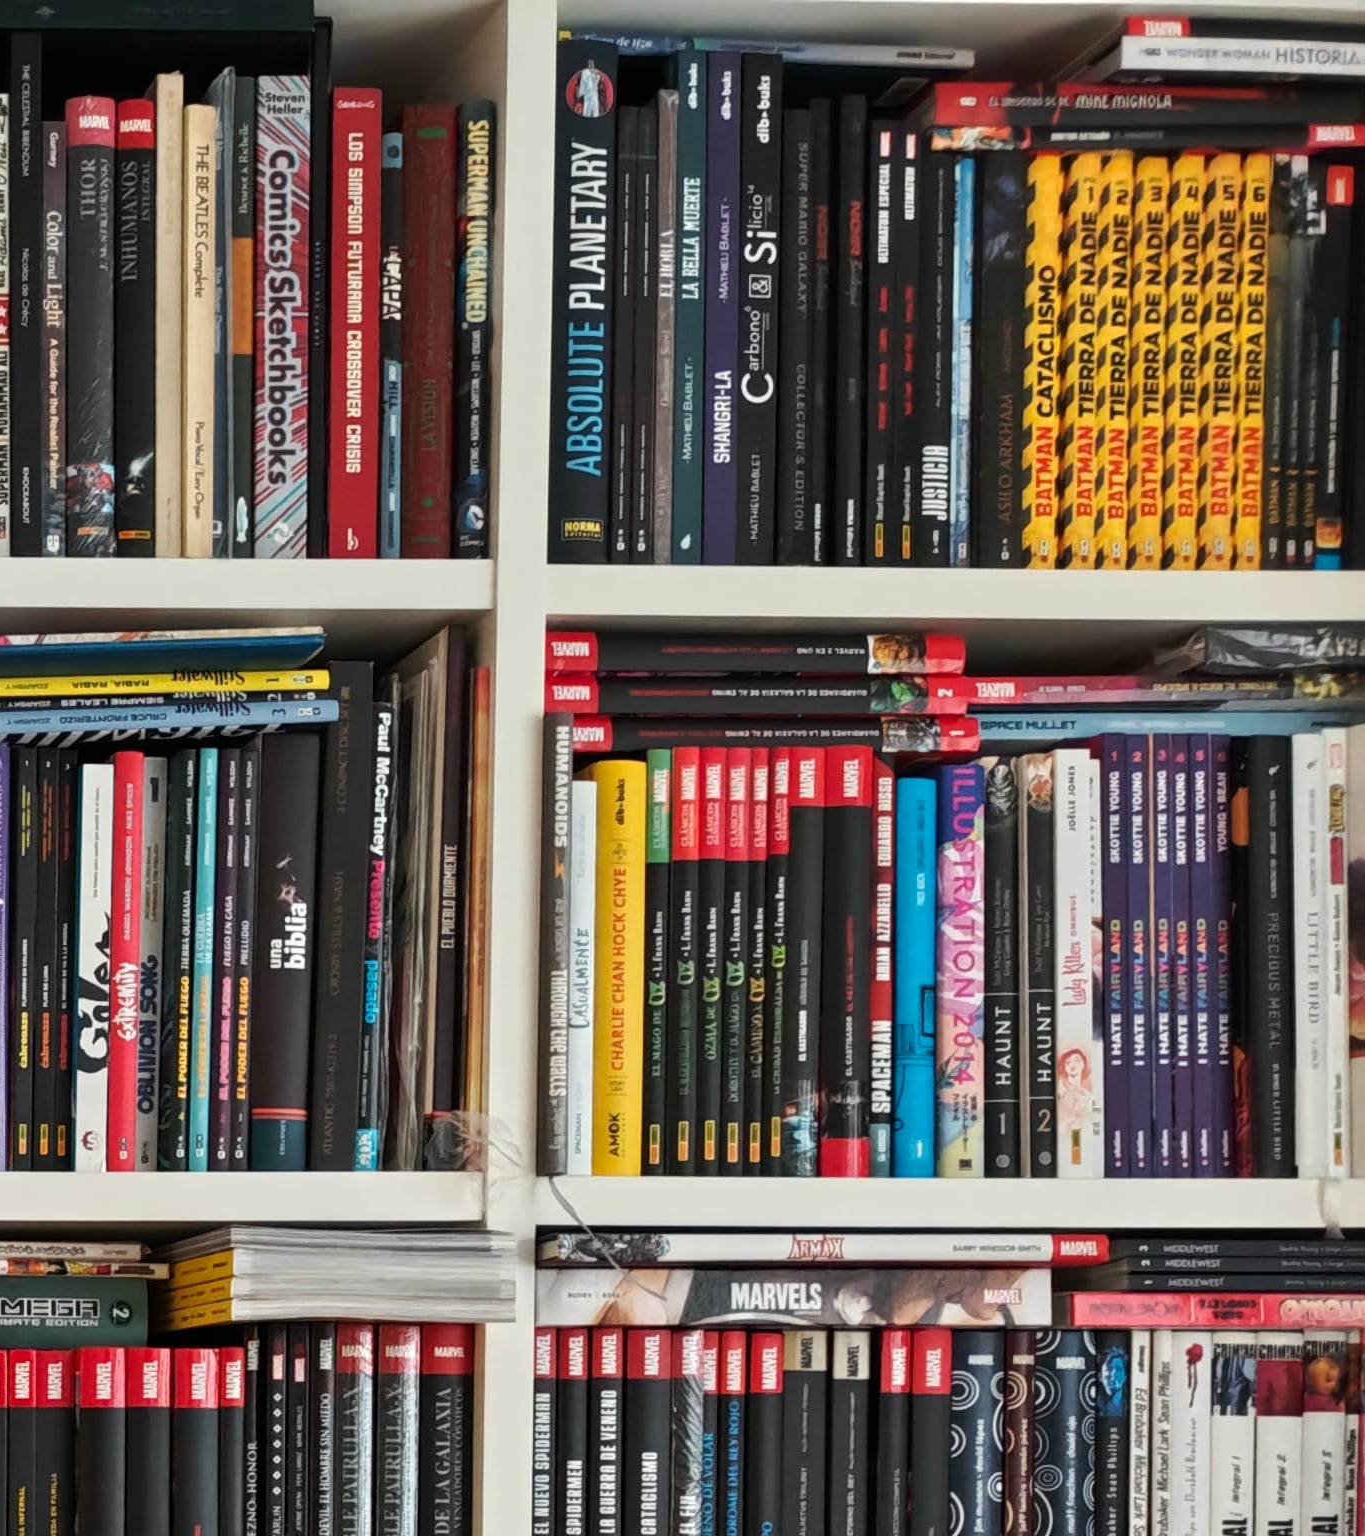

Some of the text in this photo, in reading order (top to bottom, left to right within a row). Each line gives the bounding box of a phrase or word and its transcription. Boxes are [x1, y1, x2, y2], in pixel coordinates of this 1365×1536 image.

[264, 91, 306, 105] Steven
[266, 103, 304, 115] Heller
[268, 149, 300, 486] Comics Sketchbooks
[345, 132, 364, 475] LOS SIMPSON FUTURAMA CROSSOVER CRISIS
[566, 140, 609, 477] ABSOLUTE PLANETARY
[713, 370, 732, 464] SHANGRI-LA
[1034, 264, 1056, 518] BATMAN CATACLISMO
[269, 938, 282, 969] una
[284, 902, 307, 970] biblia
[610, 867, 627, 1071] CHARLIE CHAN HOCK CHYE
[994, 1005, 1012, 1086] HAUNT
[731, 1282, 822, 1311] MARVELS
[640, 1452, 657, 1535] CATACLISMO
